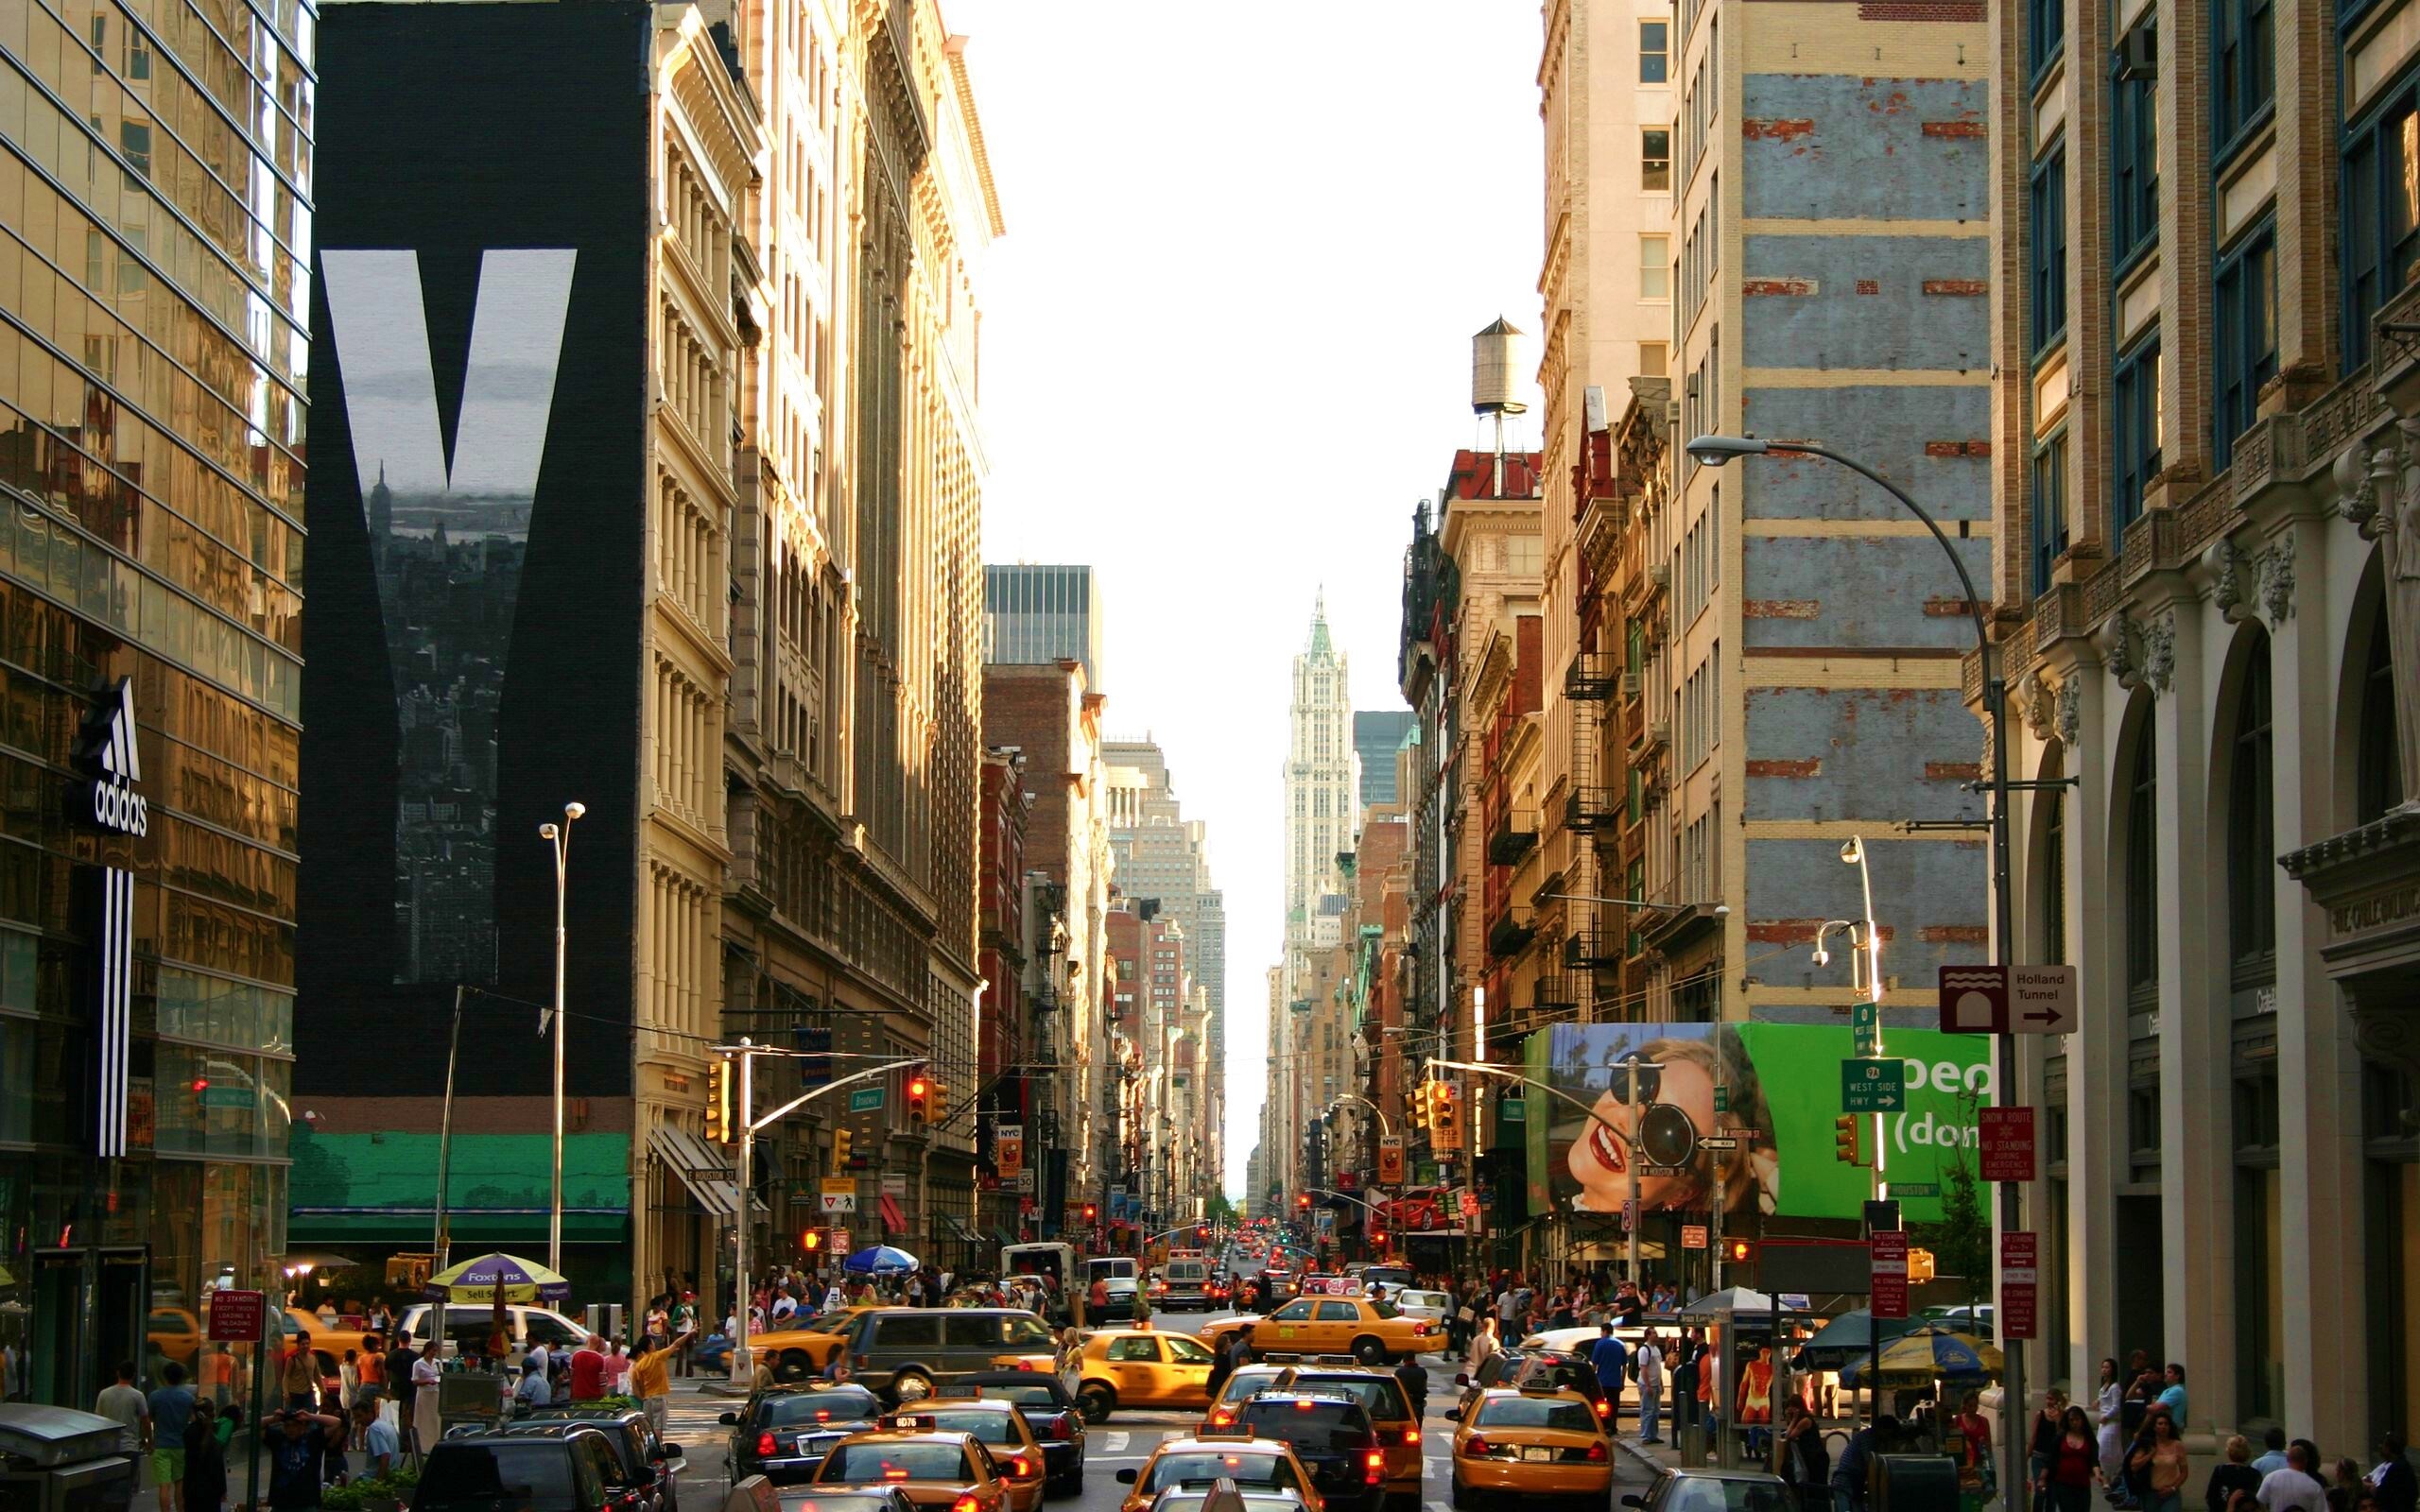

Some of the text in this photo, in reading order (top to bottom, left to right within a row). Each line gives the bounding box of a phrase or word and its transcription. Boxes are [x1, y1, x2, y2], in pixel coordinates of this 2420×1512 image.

[95, 772, 147, 838] adidas
[2016, 973, 2065, 985] Holland
[2018, 989, 2058, 1000] Tunnel
[1867, 1068, 1878, 1077] 9A
[1849, 1082, 1896, 1091] WEST SIDE
[1850, 1097, 1869, 1106] HWY
[1980, 1112, 2031, 1124] SNOW ROUTE
[1981, 1141, 2032, 1151] NO STANDING
[1986, 1160, 2028, 1169] EMERGENCY
[695, 1172, 724, 1180] HOUSTON
[726, 1172, 735, 1180] ST
[1649, 1167, 1674, 1176] HOUSTON
[1678, 1167, 1685, 1176] ST
[1020, 1177, 1032, 1186] 30
[1891, 1185, 1929, 1195] HOUSTON
[1571, 1229, 1606, 1242] HSBC
[468, 1272, 521, 1281] Foxtns
[467, 1290, 519, 1300] Sell Srt.
